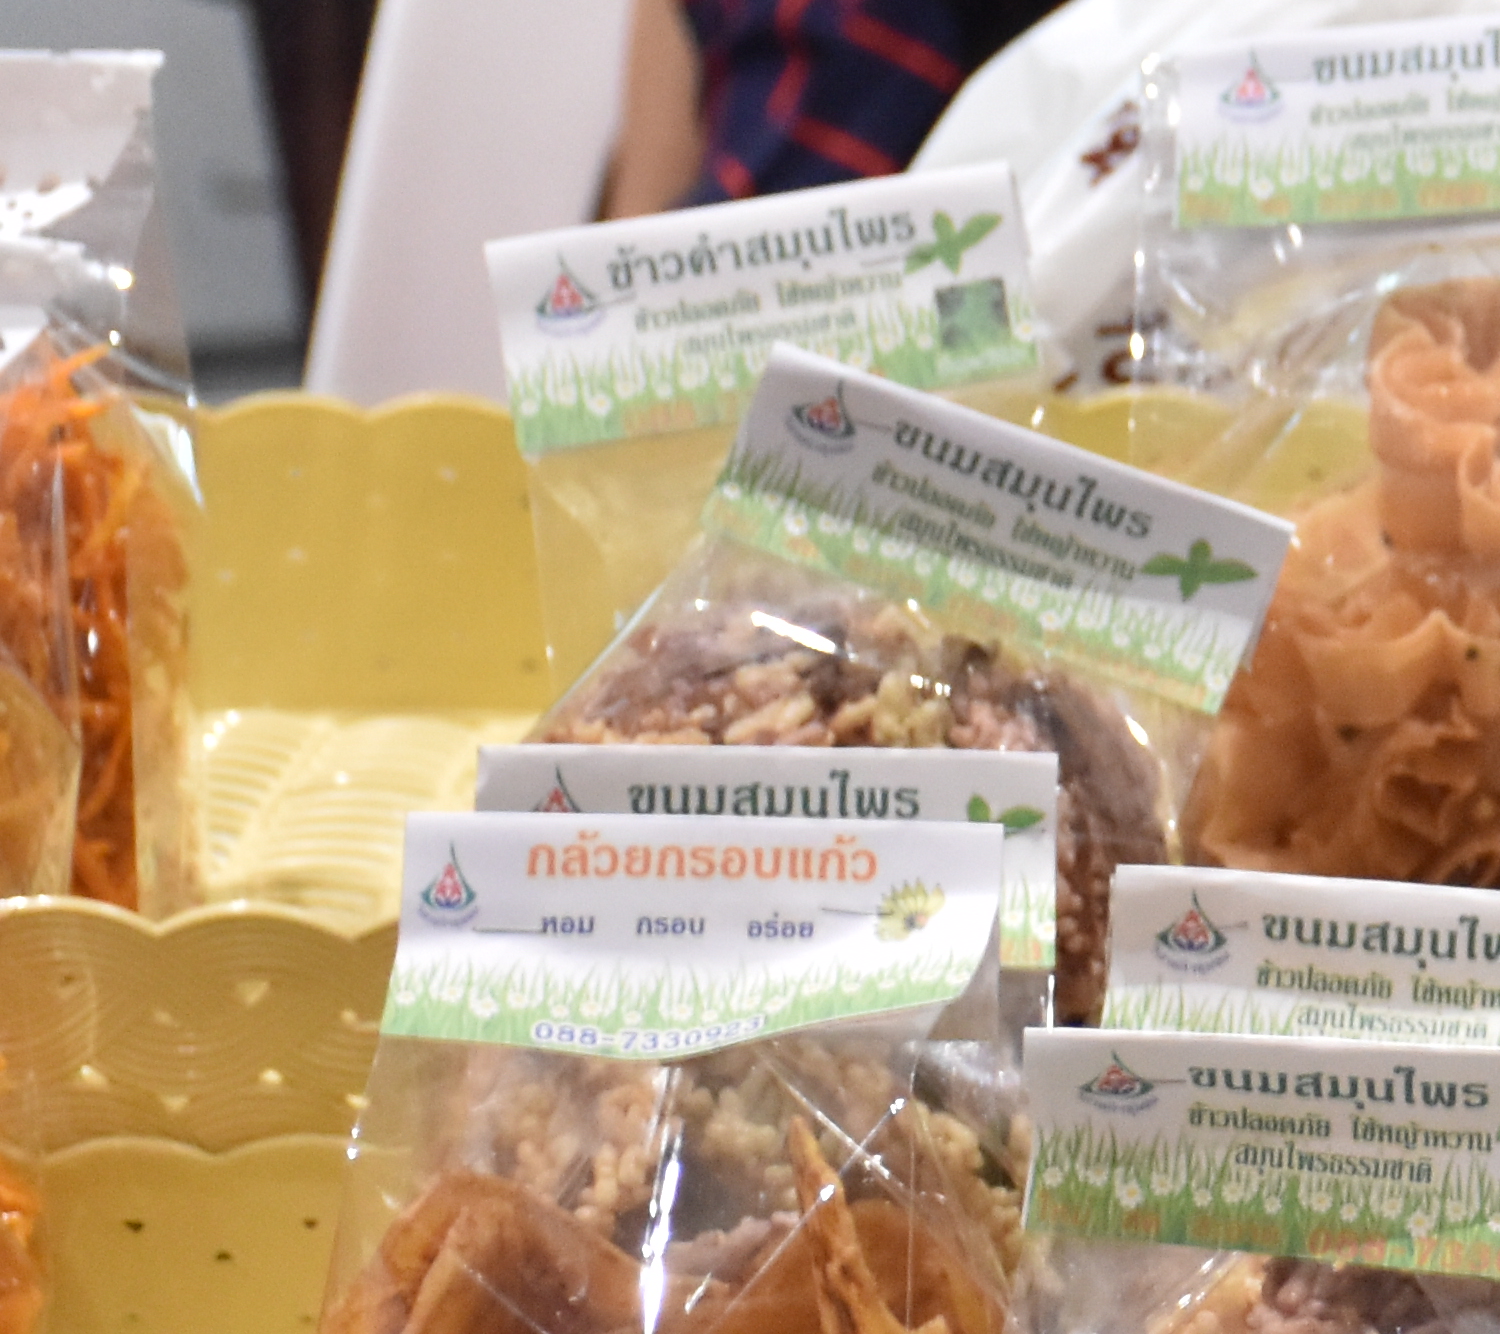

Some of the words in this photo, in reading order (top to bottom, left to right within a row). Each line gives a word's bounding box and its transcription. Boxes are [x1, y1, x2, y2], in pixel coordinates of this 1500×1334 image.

[893, 423, 1153, 540] ขนมสมุนไพร
[626, 768, 921, 820] ขนมสมนไพร
[524, 829, 879, 884] กล้วยกรอบแก้ว
[541, 912, 596, 937] หอม
[635, 912, 706, 936] กรอบ
[746, 910, 816, 940] อร่อย
[534, 1014, 766, 1051] 088-7330923
[1187, 1065, 1491, 1111] ขนมสมุนไพร
